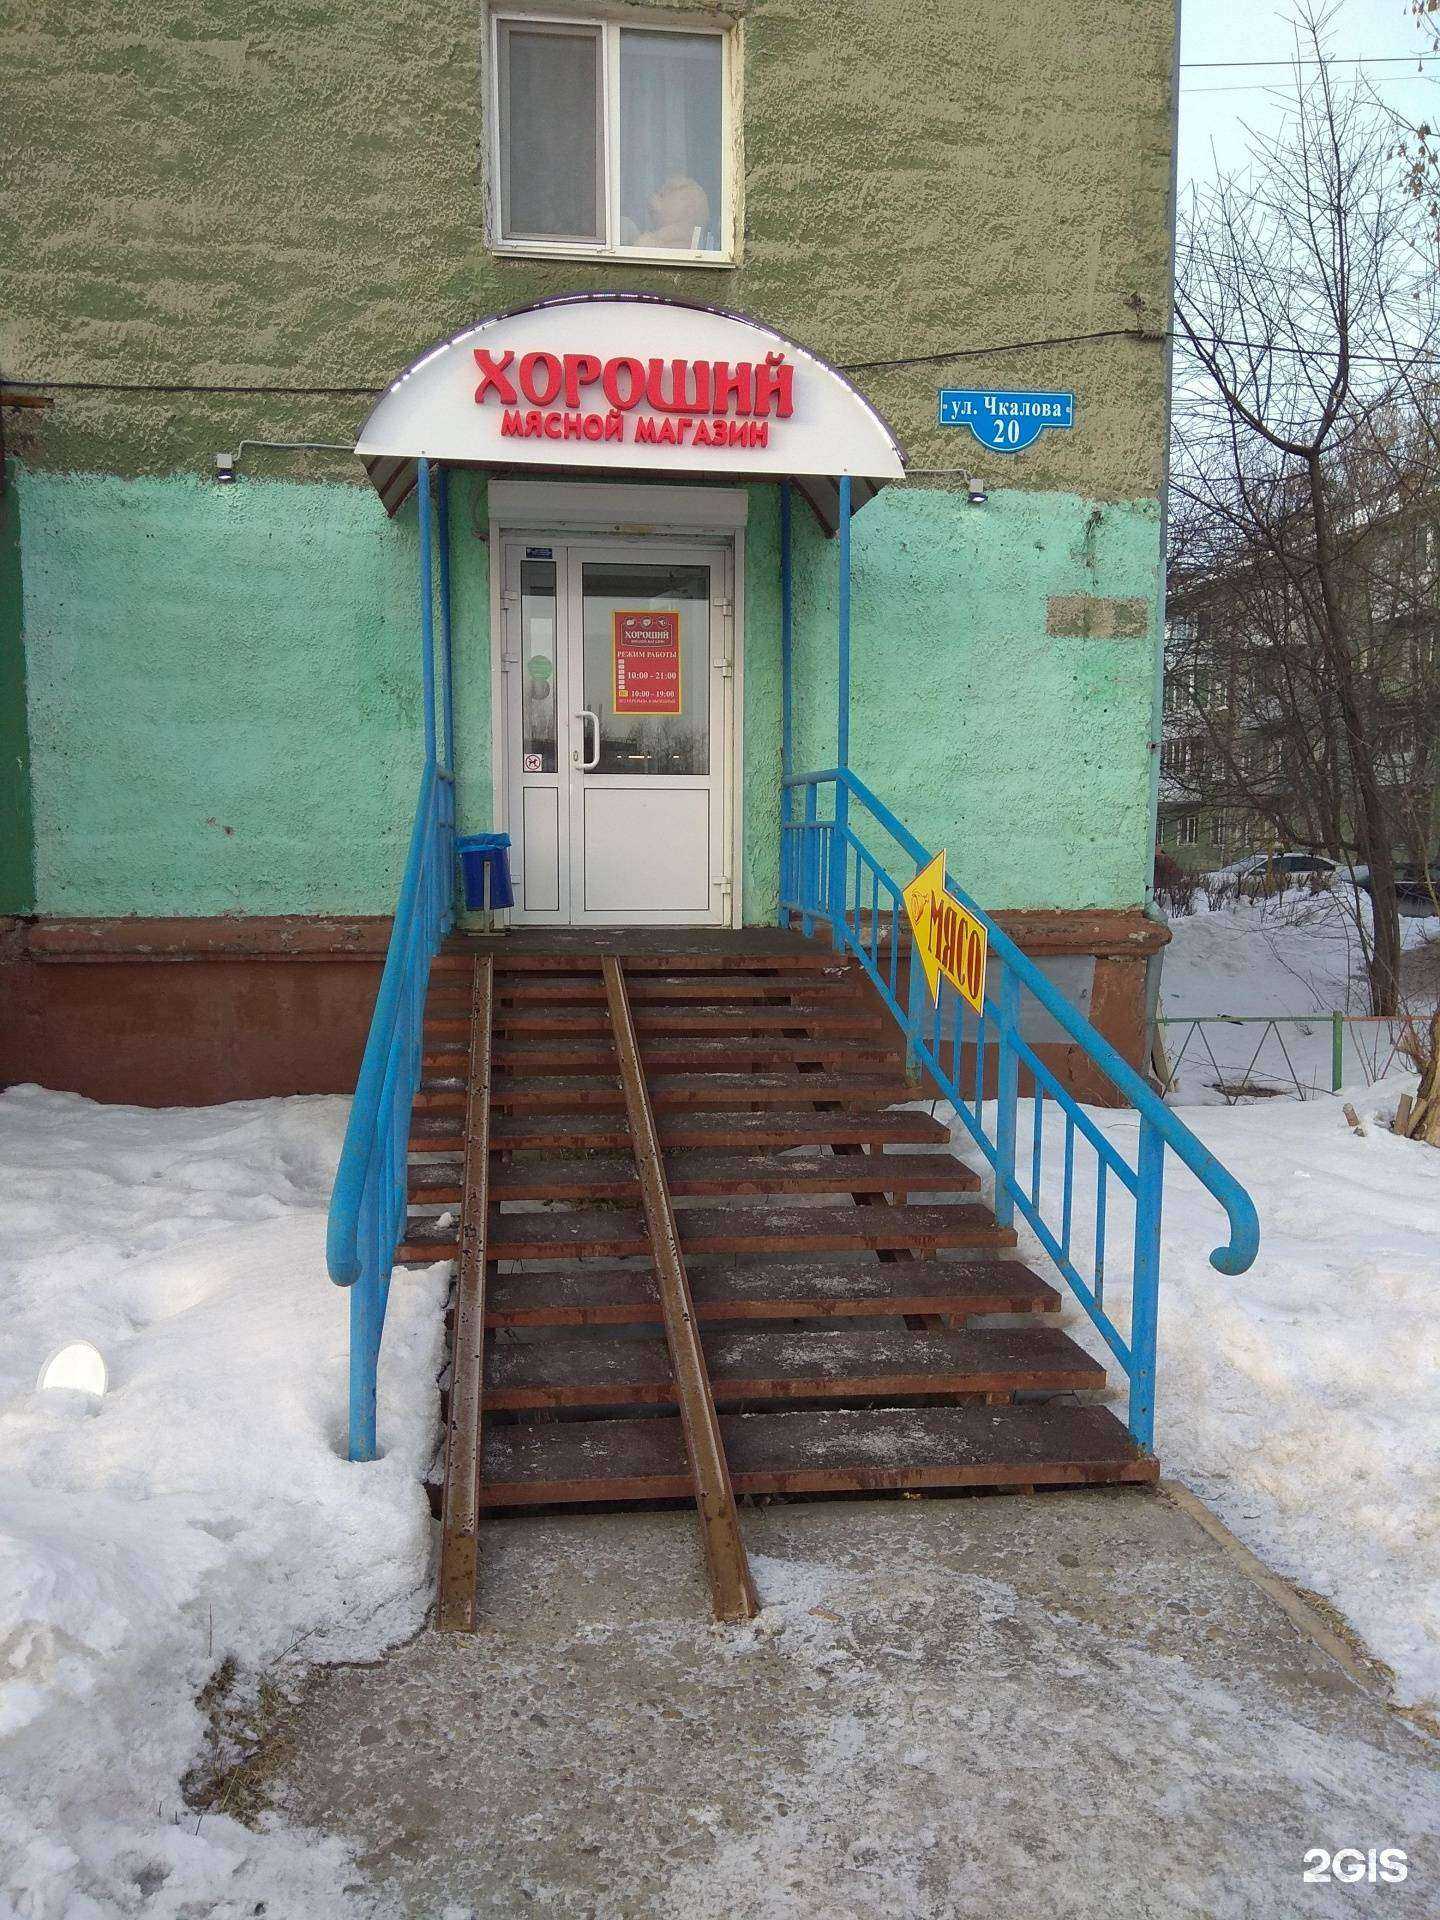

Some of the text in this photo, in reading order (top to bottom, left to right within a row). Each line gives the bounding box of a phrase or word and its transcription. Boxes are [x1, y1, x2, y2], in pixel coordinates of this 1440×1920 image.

[473, 348, 795, 418] ХОРОШИЙ
[951, 396, 1061, 420] ул. Чкалова
[500, 408, 769, 448] МЯСНОЙ МАГАЗИН
[992, 419, 1020, 444] 20
[625, 630, 669, 639] ХОРОШИЙ
[646, 651, 677, 659] РАБОТЫ
[627, 671, 649, 680] 10:00
[655, 671, 677, 680] 21:00
[631, 690, 650, 698] 10:00
[656, 690, 675, 698] 19:00
[928, 890, 982, 1000] МЯСО
